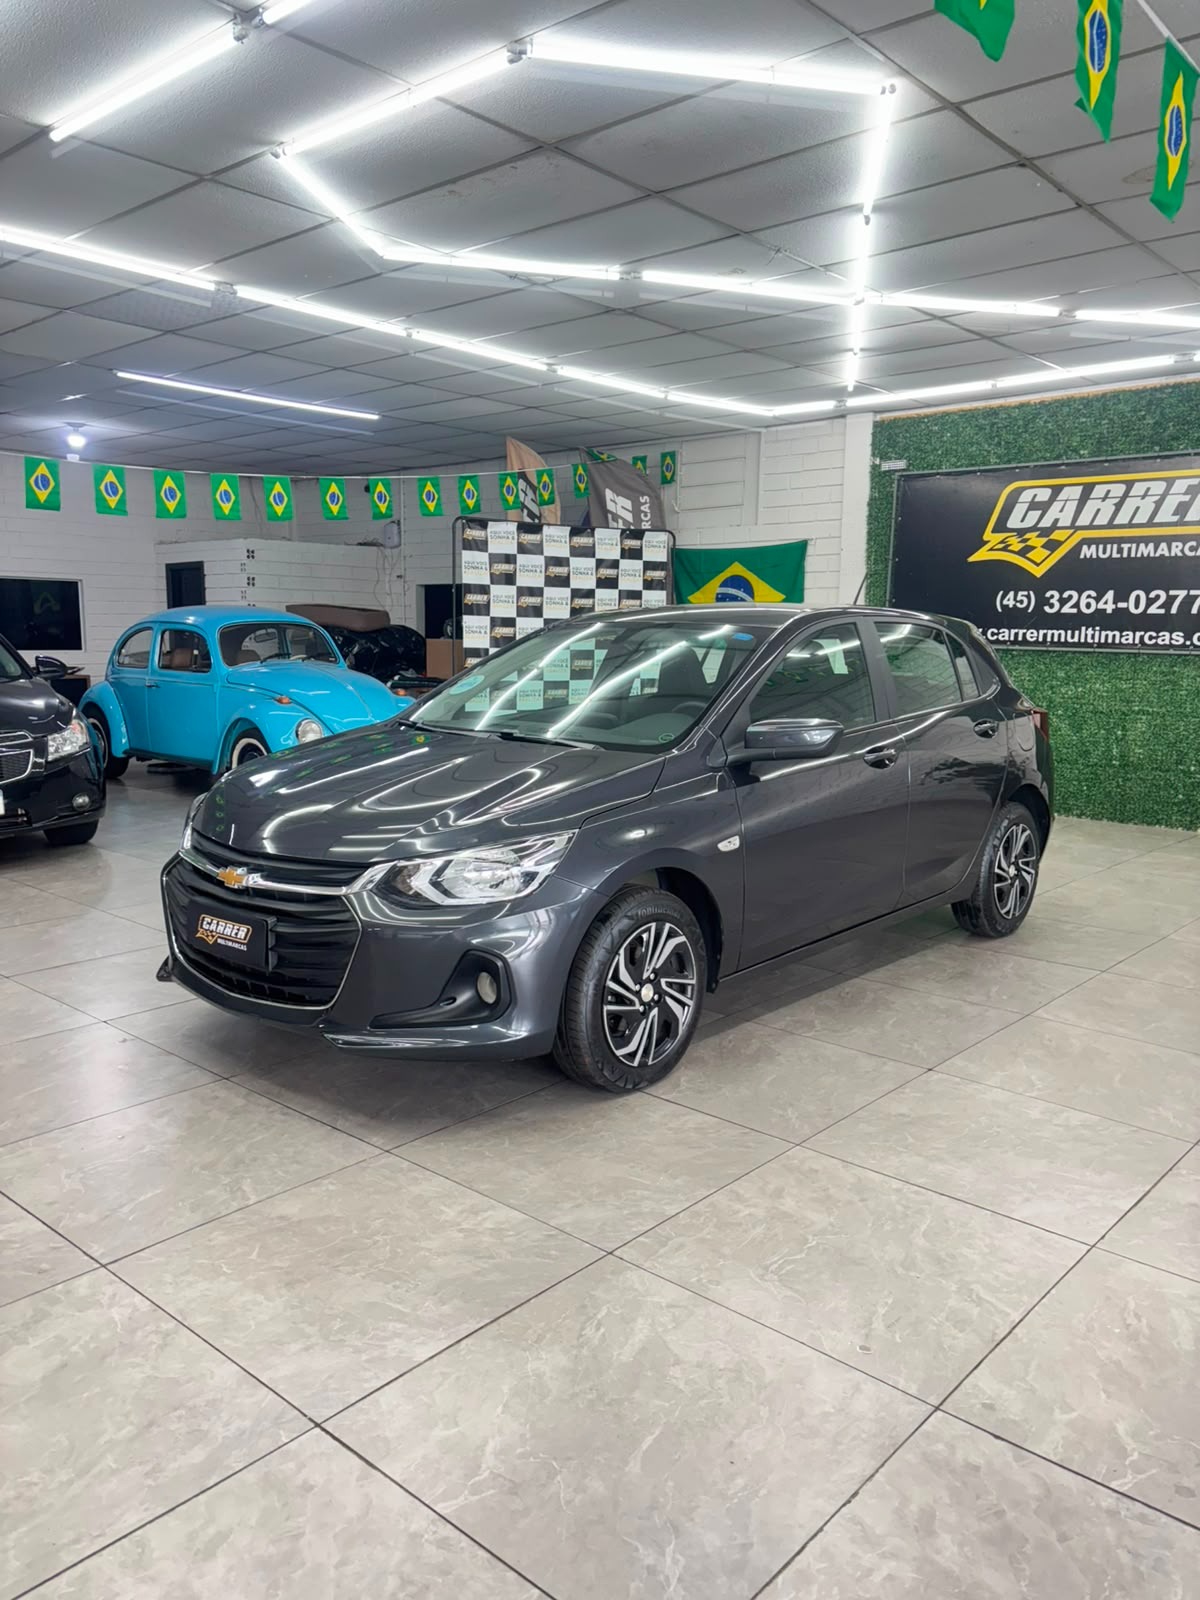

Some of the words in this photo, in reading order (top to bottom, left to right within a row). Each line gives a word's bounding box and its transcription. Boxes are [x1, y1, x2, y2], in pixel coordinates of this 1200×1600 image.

[1080, 541, 1200, 559] MULTIMARC
[996, 590, 1035, 613] (45)
[1043, 589, 1200, 615] 3264-0277
[202, 918, 247, 940] CARRER
